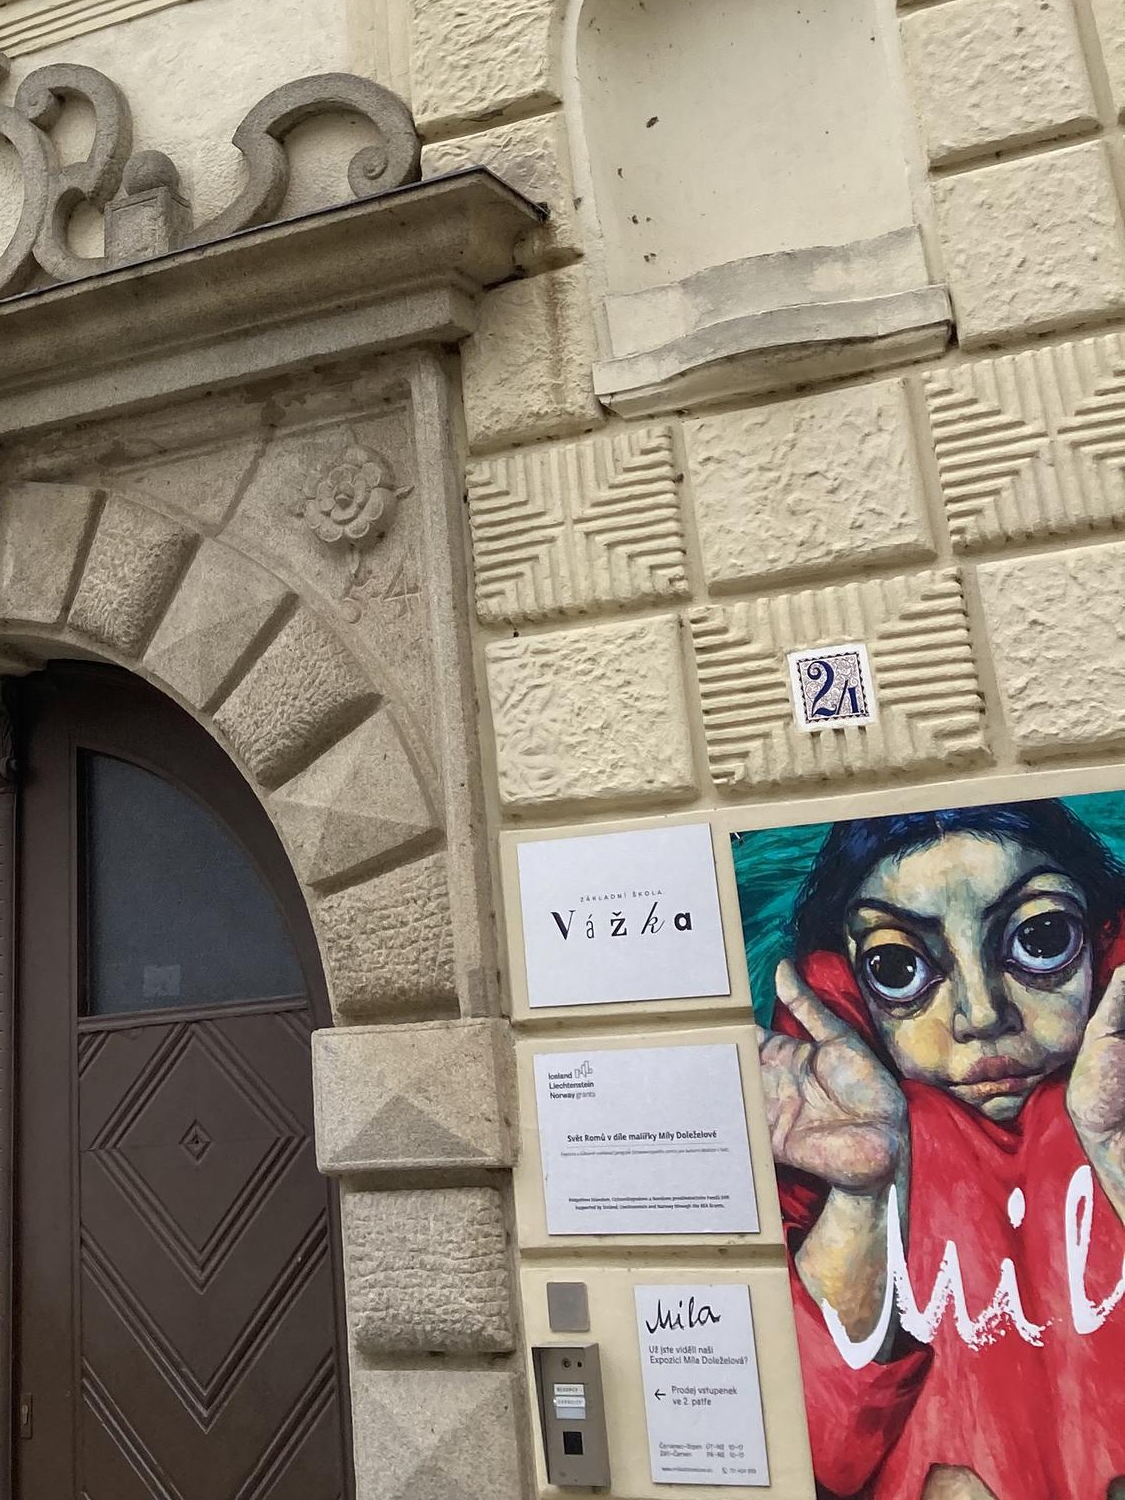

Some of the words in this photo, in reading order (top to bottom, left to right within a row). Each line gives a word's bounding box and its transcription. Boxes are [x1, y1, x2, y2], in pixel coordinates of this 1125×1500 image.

[550, 901, 693, 941] Vážka
[548, 1072, 572, 1080] Iceland
[548, 1082, 594, 1090] Liechtenstein
[550, 1092, 575, 1100] Norway
[567, 1134, 583, 1143] Svět
[584, 1133, 606, 1142] Romů
[613, 1133, 627, 1141] díle
[676, 1130, 717, 1140] Doleželové
[822, 1165, 1125, 1370] Mil
[648, 1345, 659, 1354] Už
[660, 1345, 674, 1355] jste
[698, 1345, 714, 1354] naši
[650, 1355, 682, 1365] Expozici
[701, 1355, 748, 1365] Doleželová?
[671, 1385, 696, 1396] Prodej
[697, 1386, 738, 1396] vstupenek
[691, 1397, 712, 1407] patře
